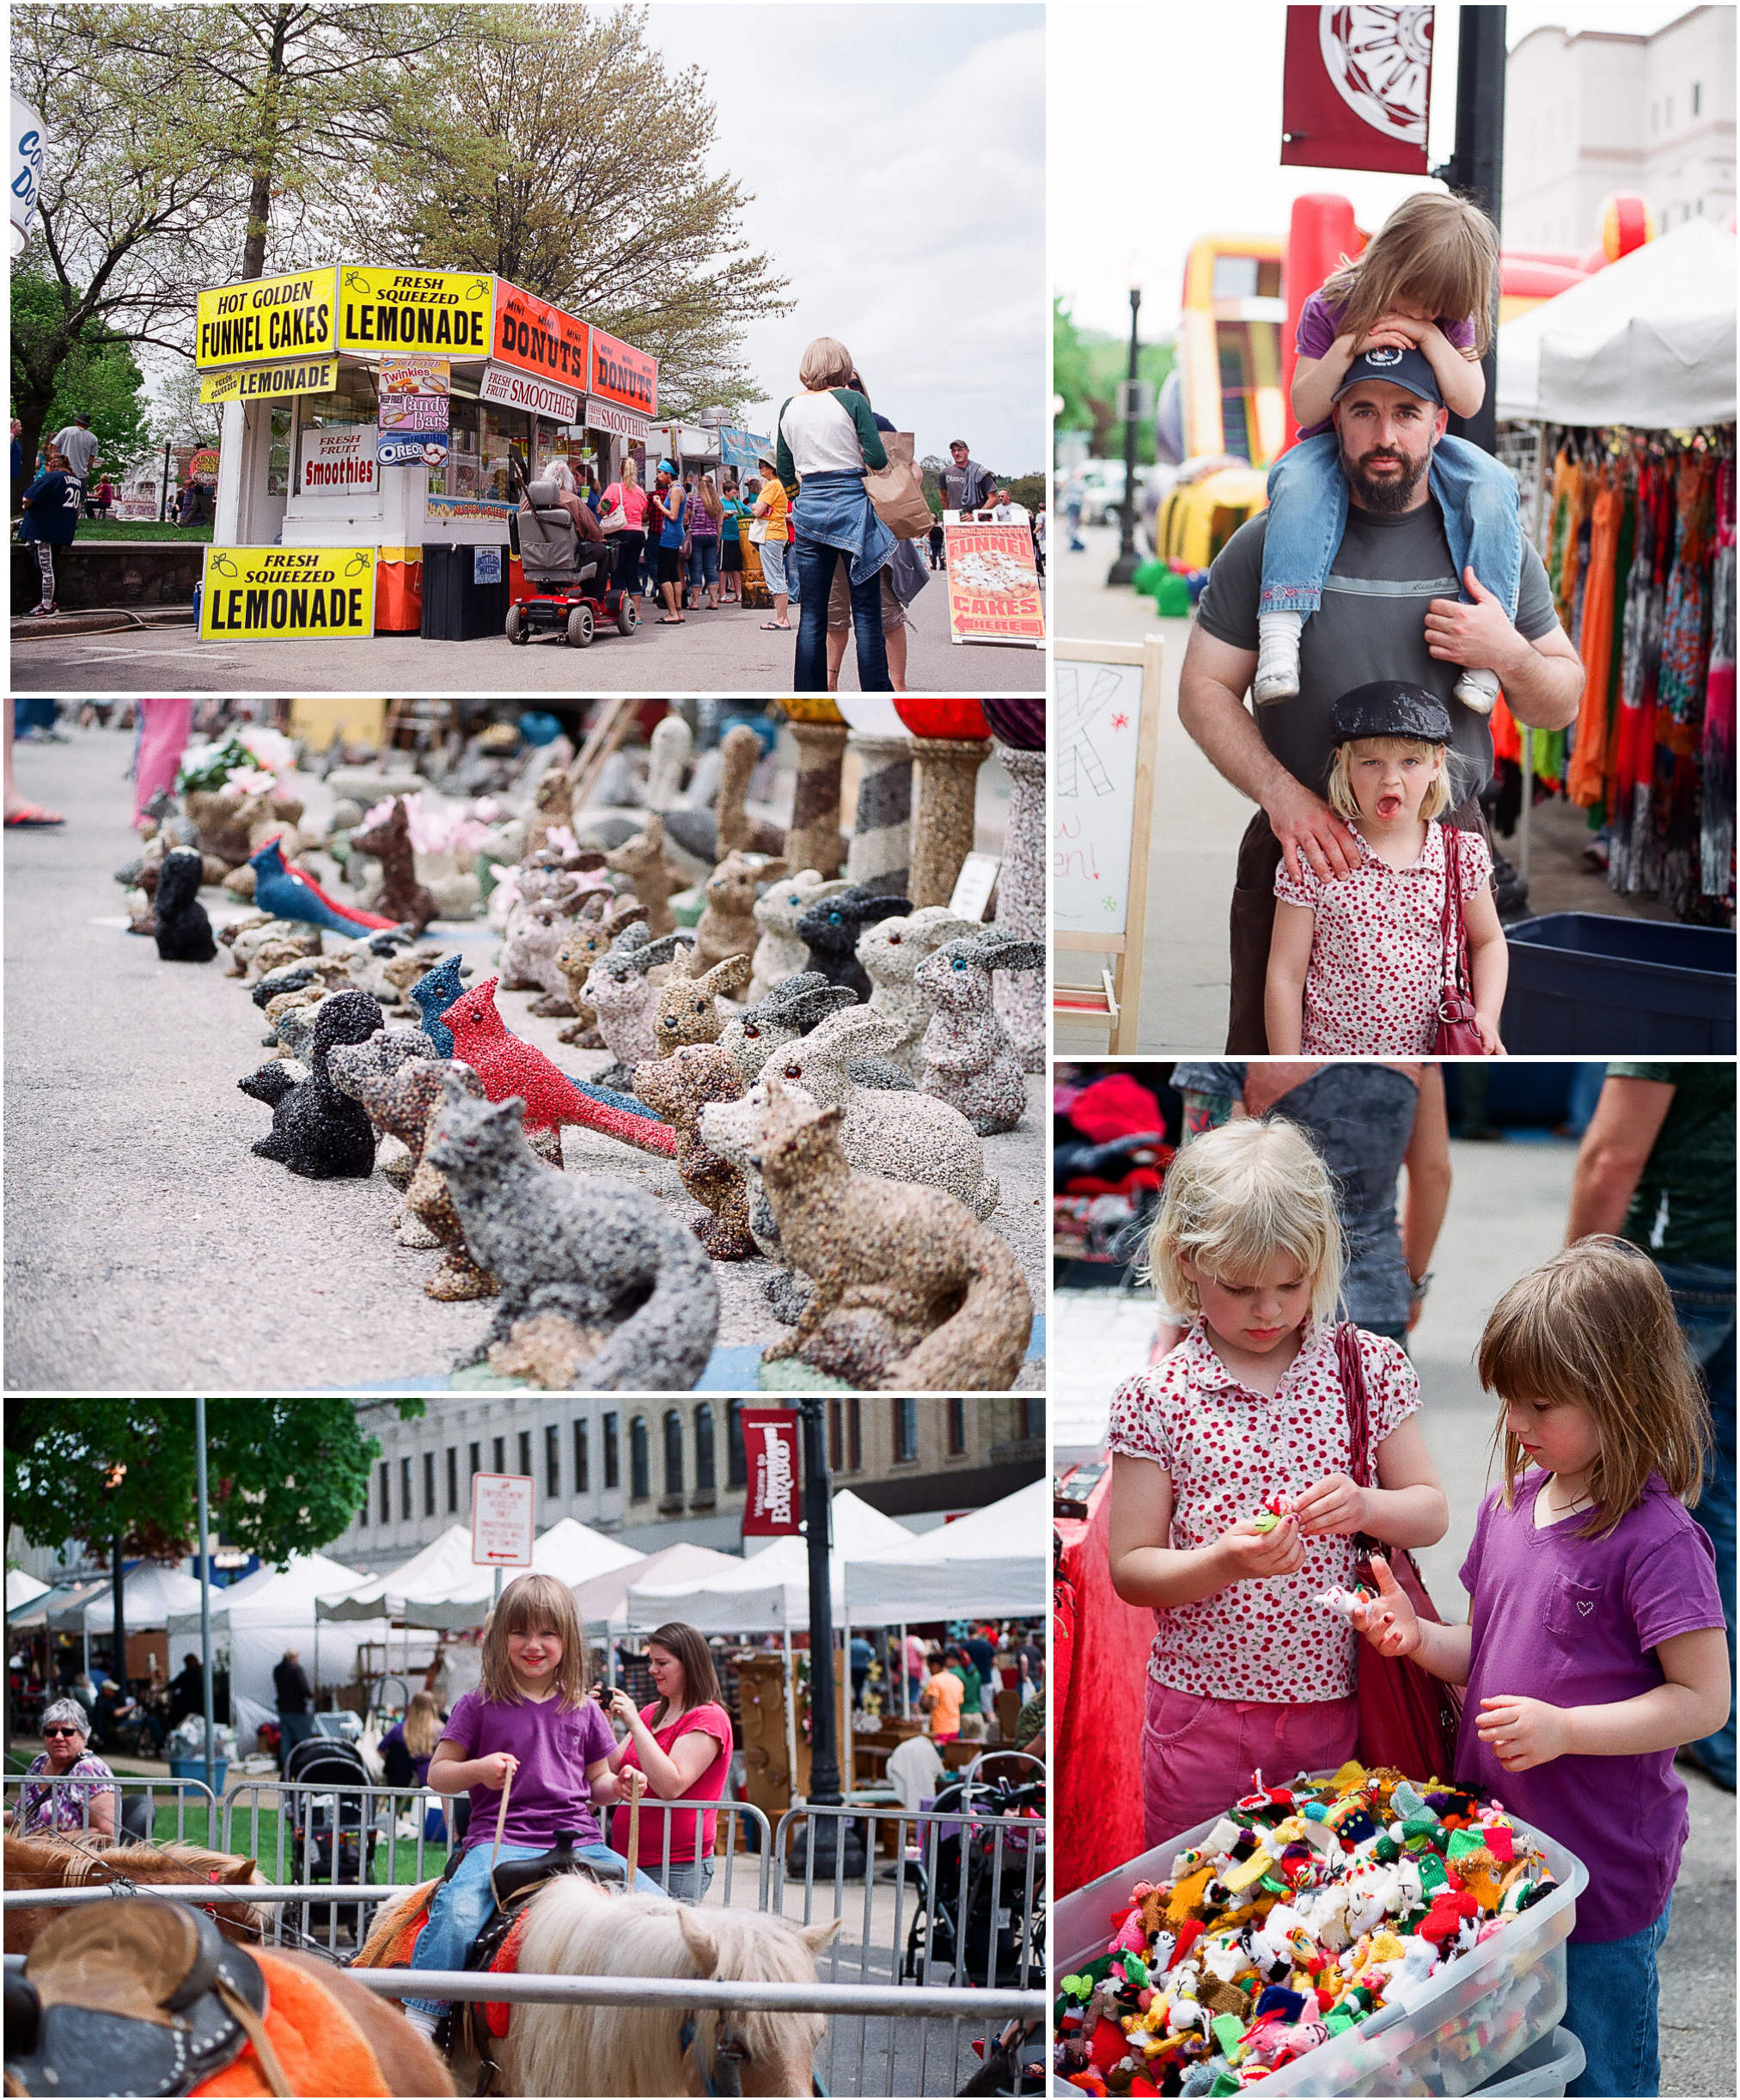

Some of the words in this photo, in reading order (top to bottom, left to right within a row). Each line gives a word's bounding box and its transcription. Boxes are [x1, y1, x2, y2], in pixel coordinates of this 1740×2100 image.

[393, 276, 444, 290] FRESH
[217, 293, 248, 314] HOT
[253, 280, 313, 308] GOLDEN
[375, 290, 460, 305] SQUEEZED
[345, 303, 484, 346] LEMONADE
[506, 300, 525, 315] MINI
[537, 314, 554, 330] MINI
[565, 328, 582, 343] MINI
[202, 315, 263, 358] FUNNEL
[269, 303, 328, 350] CAKES
[502, 314, 582, 378] DONUTS
[397, 359, 418, 368] DEEP
[601, 344, 614, 357] MINI
[622, 354, 633, 366] MINI
[642, 363, 652, 375] MINI
[215, 374, 233, 388] FRESH
[240, 364, 331, 395] LEMONADE
[382, 368, 430, 384] Twinkies
[488, 372, 511, 388] FRESH
[598, 356, 652, 405] DONUTS
[211, 380, 238, 400] SQUEEZED
[485, 384, 509, 399] FRUIT
[510, 379, 575, 418] SMOOTHIES
[404, 394, 450, 416] Candy
[588, 404, 601, 414] FRESH
[413, 412, 449, 430] Bars
[588, 414, 601, 426] FRUIT
[601, 408, 649, 439] SMOOTHIES
[319, 434, 362, 446] FRESH
[402, 435, 419, 443] DEEP
[421, 433, 443, 443] FRIED
[320, 444, 360, 455] FRUIT
[193, 455, 220, 464] FUNNE
[306, 456, 373, 486] Smoothies
[62, 487, 81, 509] 20
[454, 504, 479, 515] NACHOS
[480, 504, 485, 514] &
[486, 505, 507, 518] CHEESE
[949, 535, 1032, 559] FUNNEL
[264, 555, 320, 567] FRESH
[477, 554, 500, 566] BOTTLED
[244, 571, 335, 585] SQUEEZED
[479, 565, 498, 575] WATER
[211, 588, 363, 630] LEMONADE
[953, 595, 1038, 615] CAKES
[974, 620, 1021, 631] HERE
[756, 1453, 766, 1467] to
[770, 1438, 795, 1524] BARABOO
[753, 1468, 766, 1518] Welcome
